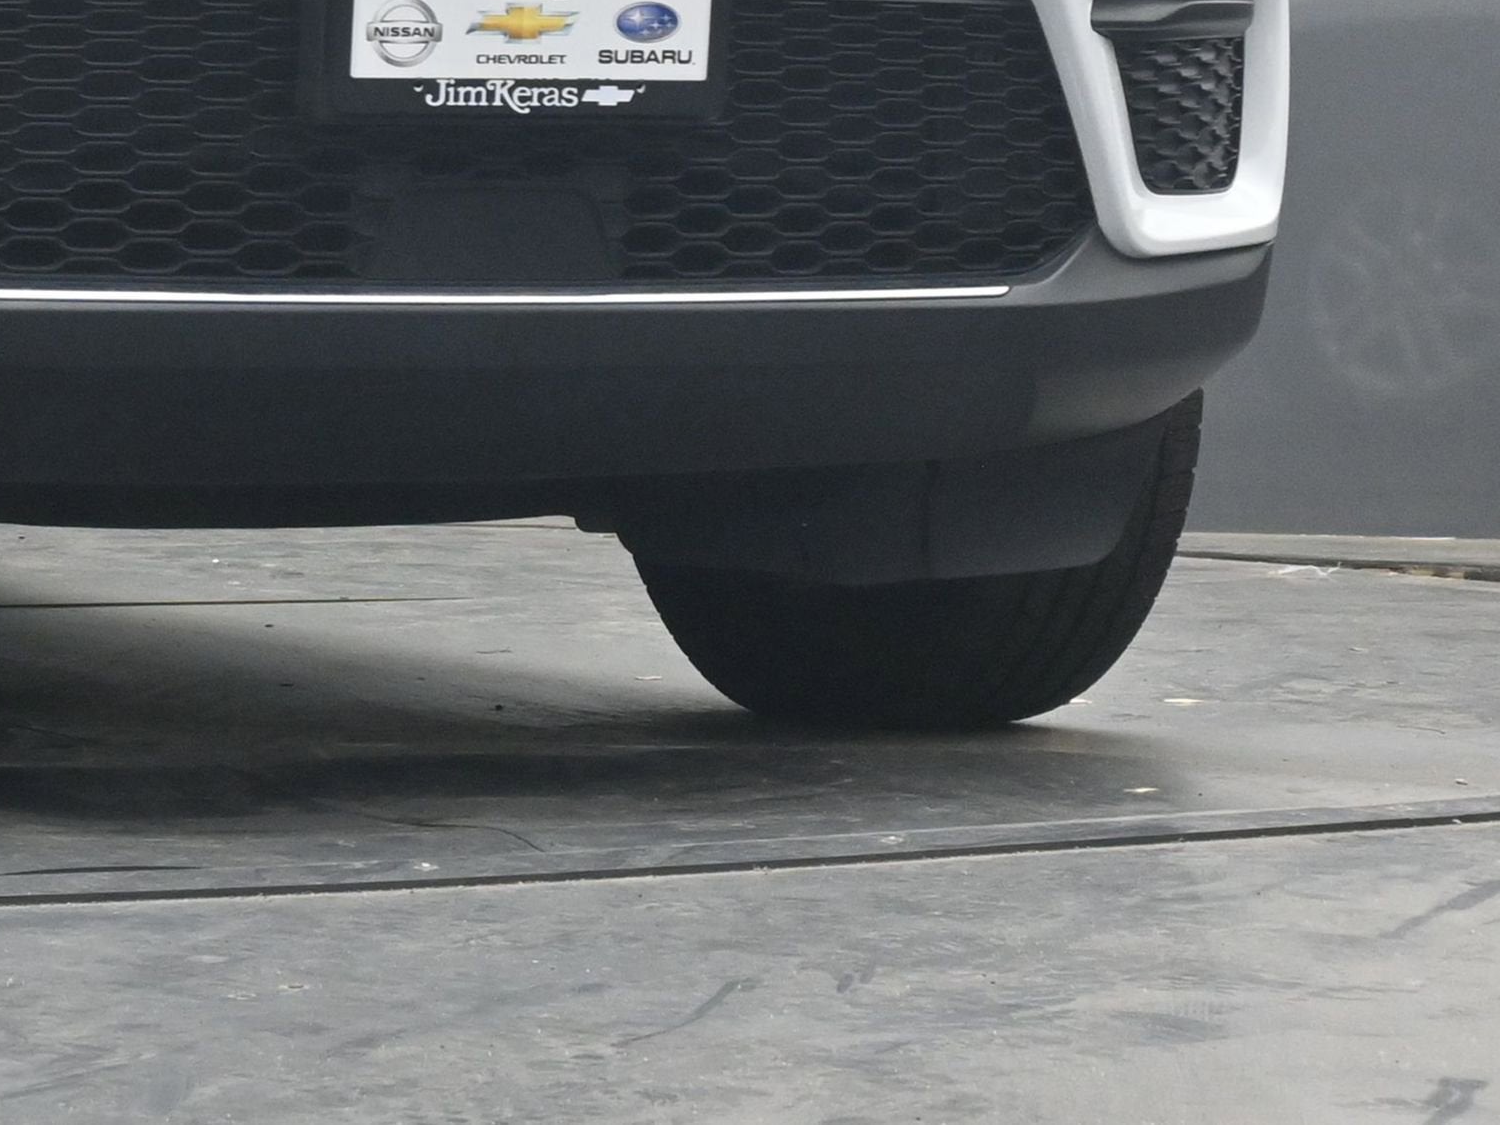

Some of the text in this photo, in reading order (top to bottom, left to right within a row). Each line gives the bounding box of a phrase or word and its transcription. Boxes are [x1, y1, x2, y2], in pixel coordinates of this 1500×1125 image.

[373, 26, 436, 39] NISSAN
[475, 53, 567, 65] CHEVROLET
[598, 49, 693, 65] SUBARU
